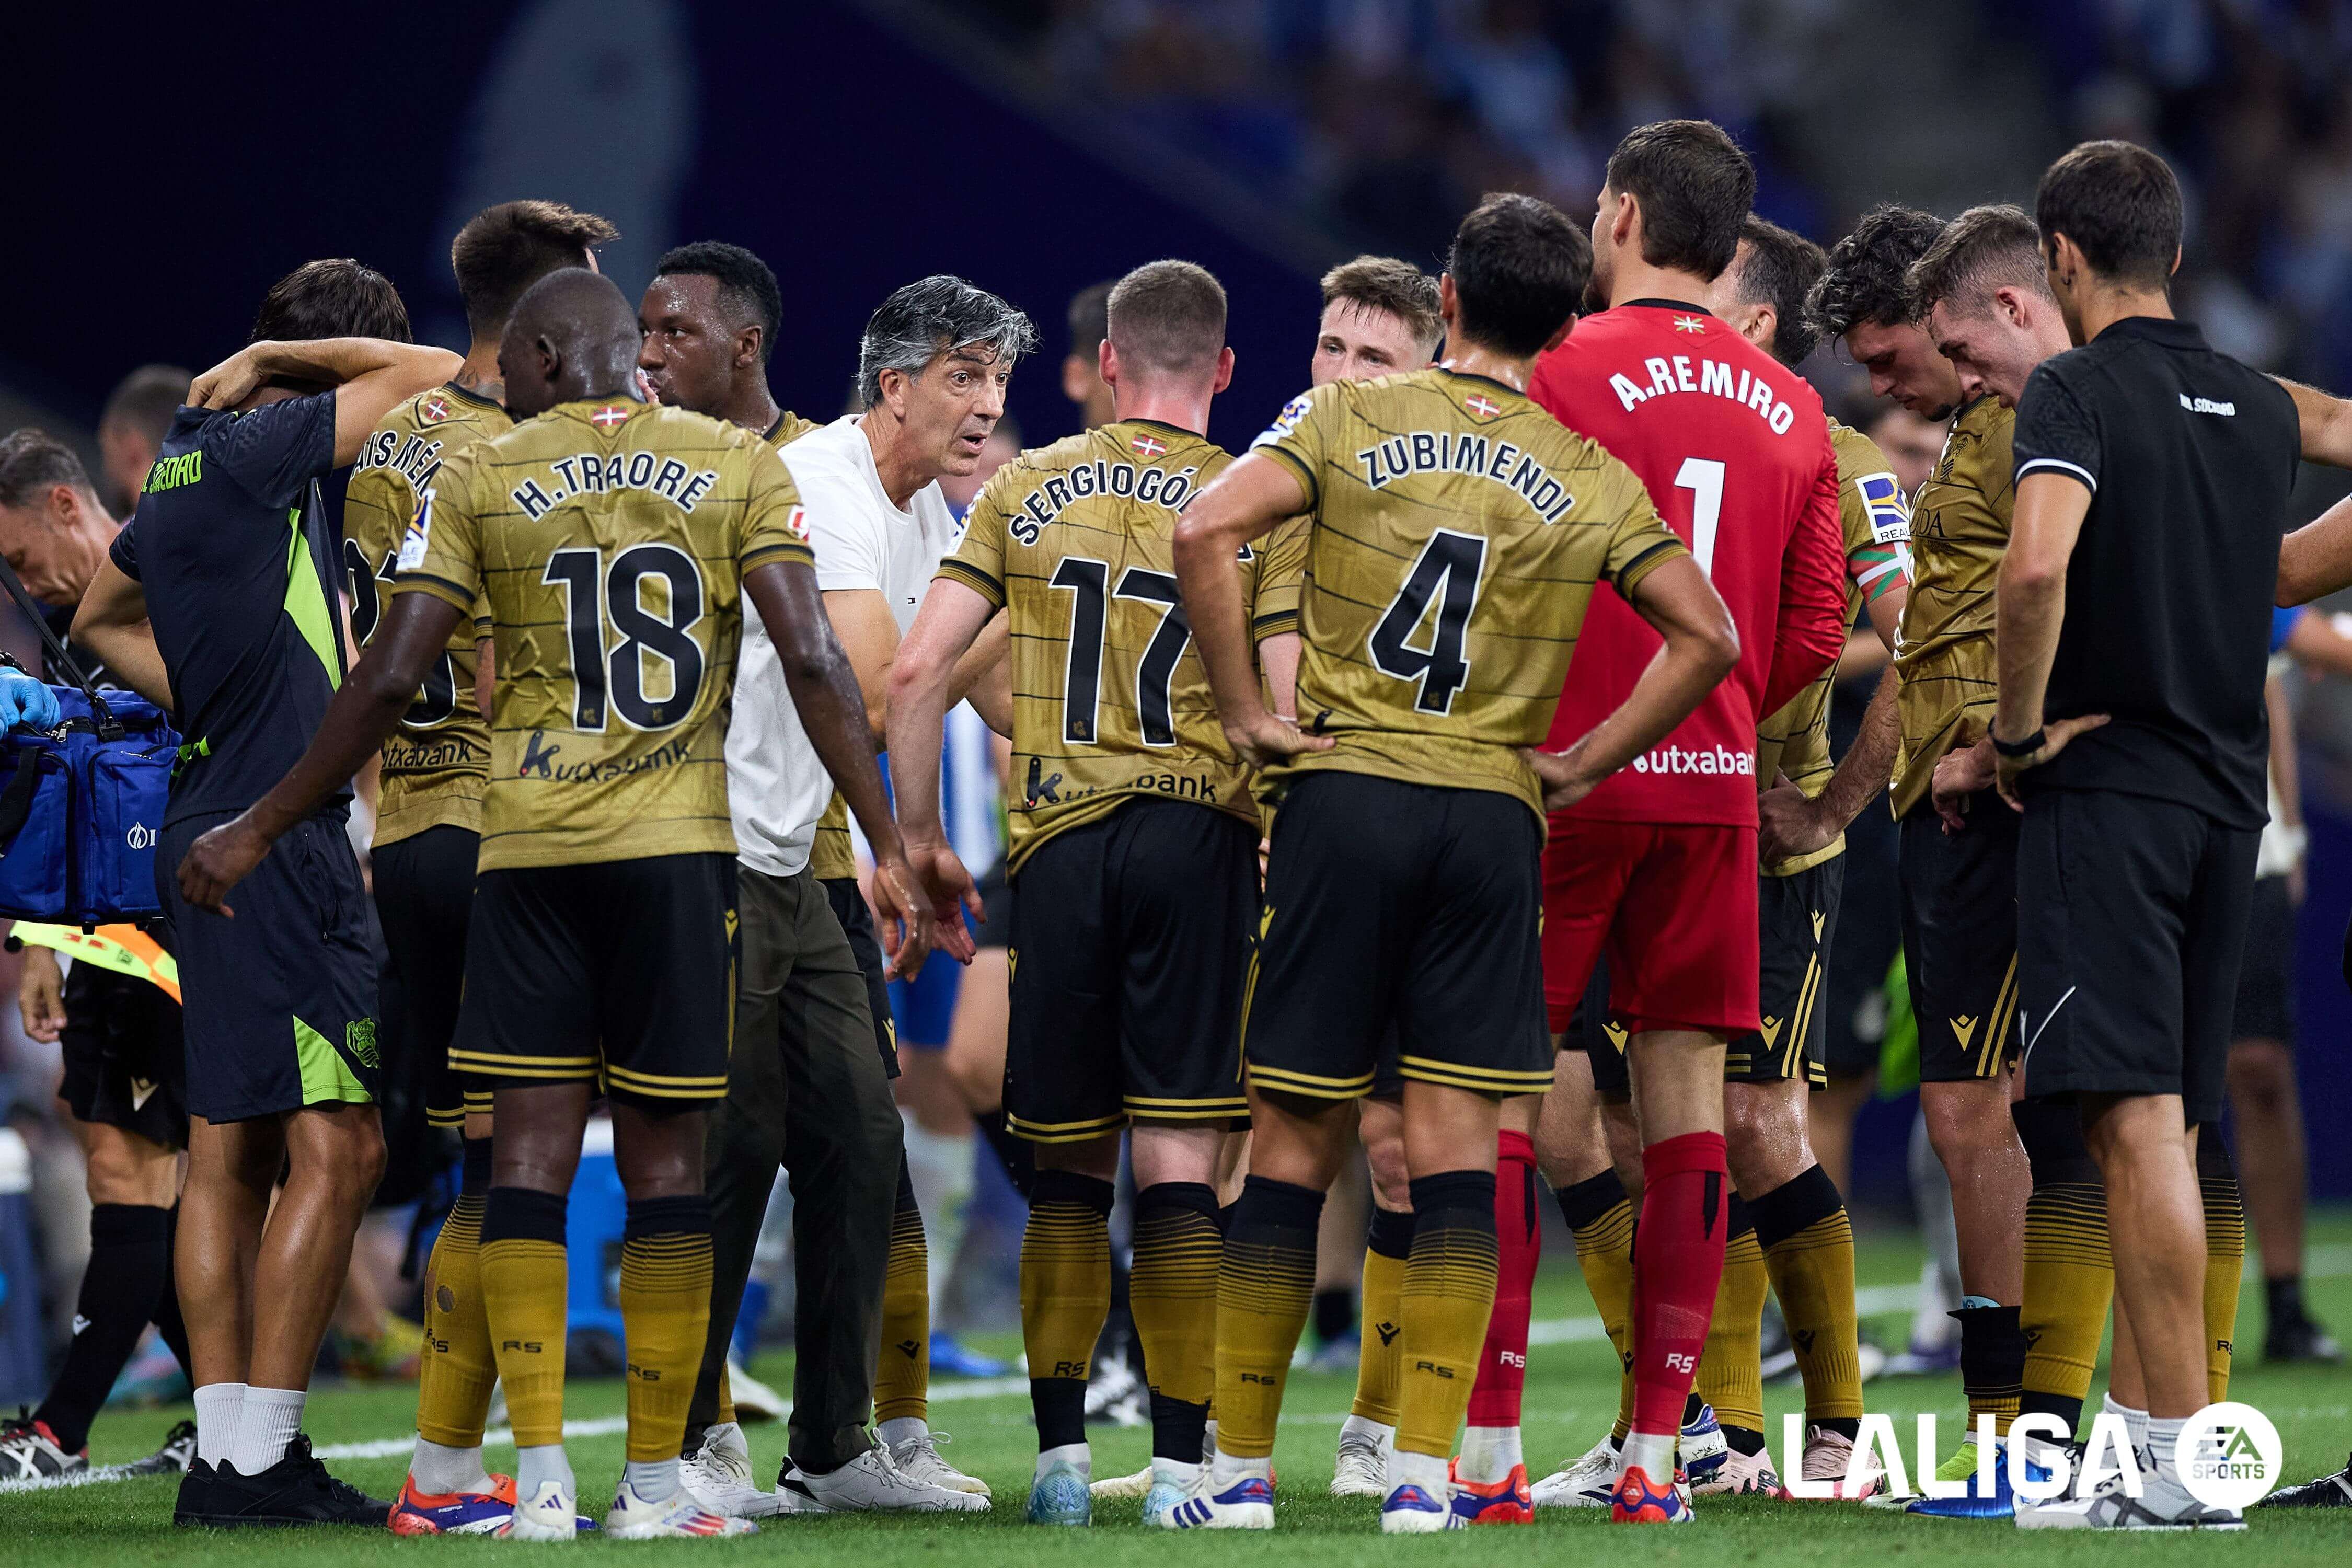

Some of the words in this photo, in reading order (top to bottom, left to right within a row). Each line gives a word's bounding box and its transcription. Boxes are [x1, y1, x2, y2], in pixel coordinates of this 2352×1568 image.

[1610, 356, 1794, 435] A.REMIRO
[510, 451, 721, 522] H.TRAORÉ
[1008, 459, 1204, 547] SERGIOGÓ
[1356, 431, 1576, 526] ZUBIMENDI
[1674, 457, 1726, 578] 1
[1880, 528, 1911, 541] REAL
[542, 541, 705, 733] 18
[1048, 556, 1193, 747] 17
[1367, 527, 1488, 717] 4
[503, 1341, 543, 1353] RS
[1054, 1361, 1086, 1377] RS
[1242, 1373, 1275, 1385] RS
[1417, 1361, 1455, 1379] RS
[1500, 1351, 1525, 1368] RS
[1665, 1353, 1695, 1374] RS
